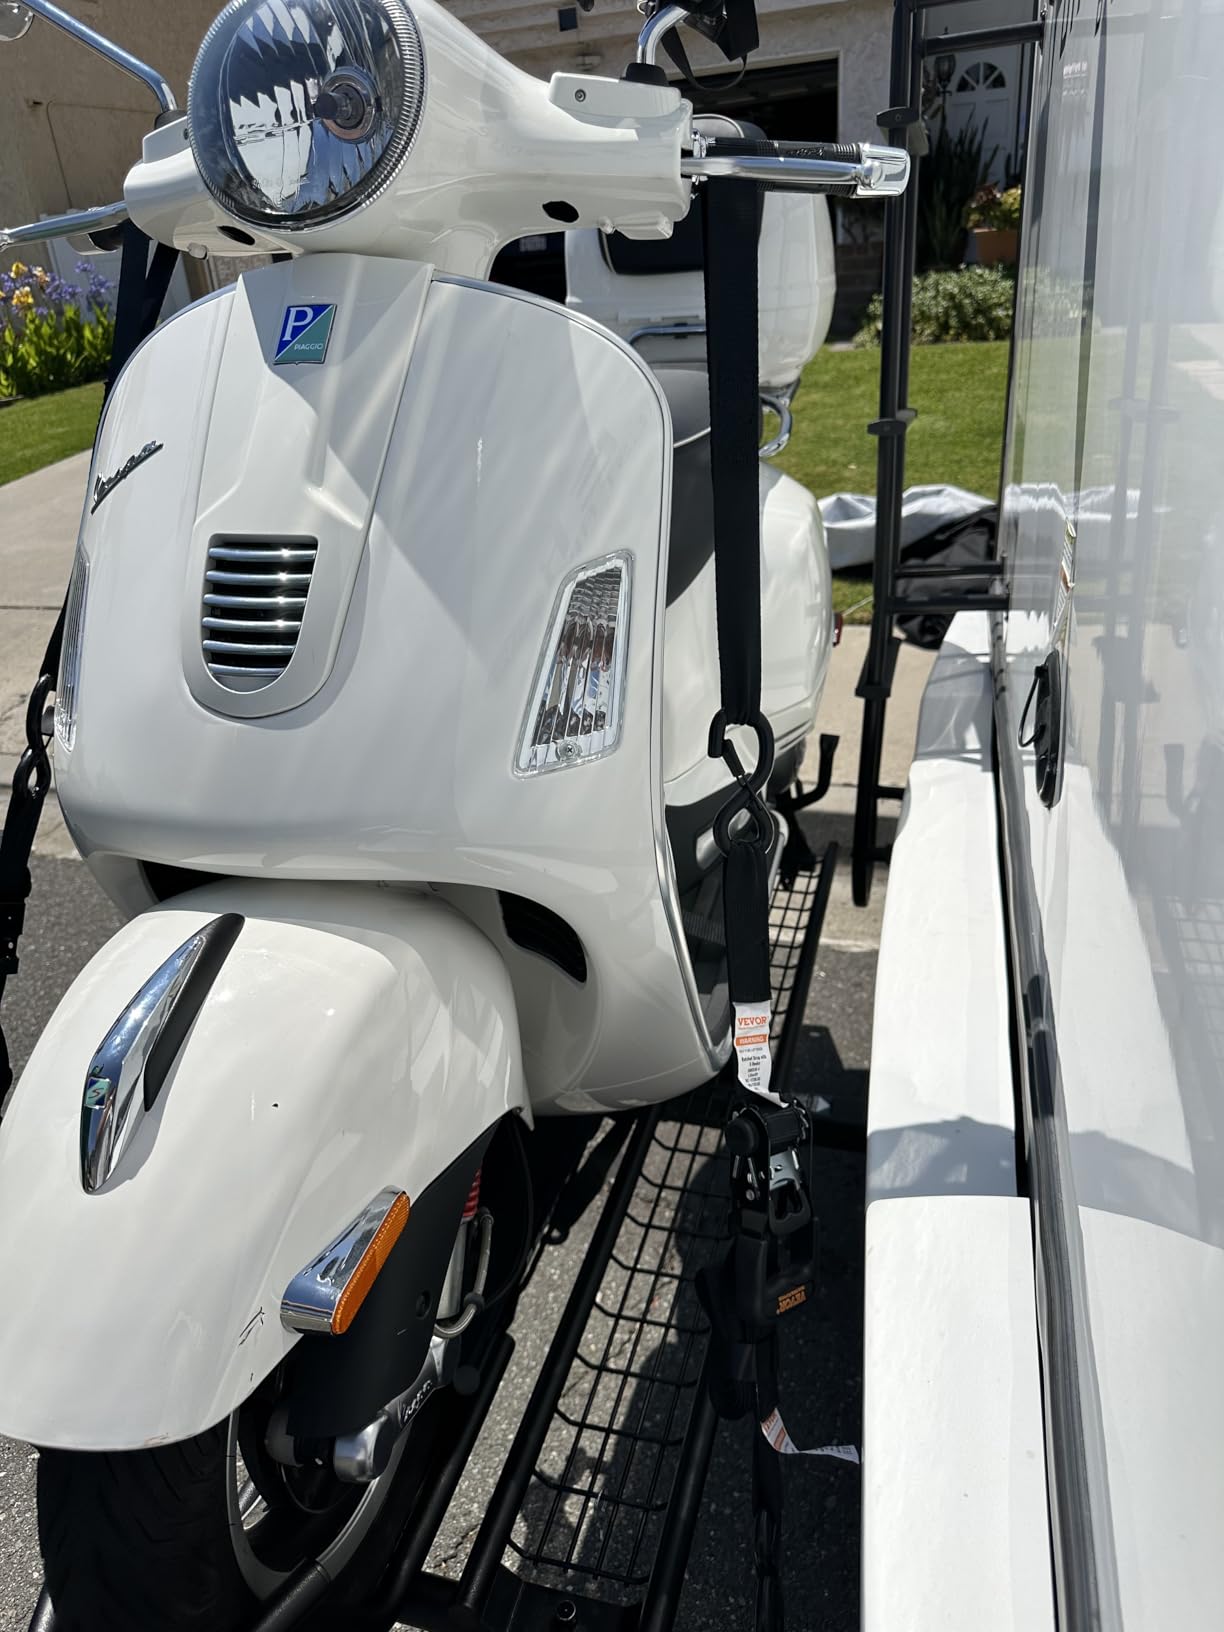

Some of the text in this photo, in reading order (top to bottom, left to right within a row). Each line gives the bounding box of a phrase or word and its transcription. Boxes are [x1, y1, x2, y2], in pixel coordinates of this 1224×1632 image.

[282, 306, 314, 341] P
[737, 1016, 767, 1026] VEVOR
[739, 1036, 765, 1044] WARNING
